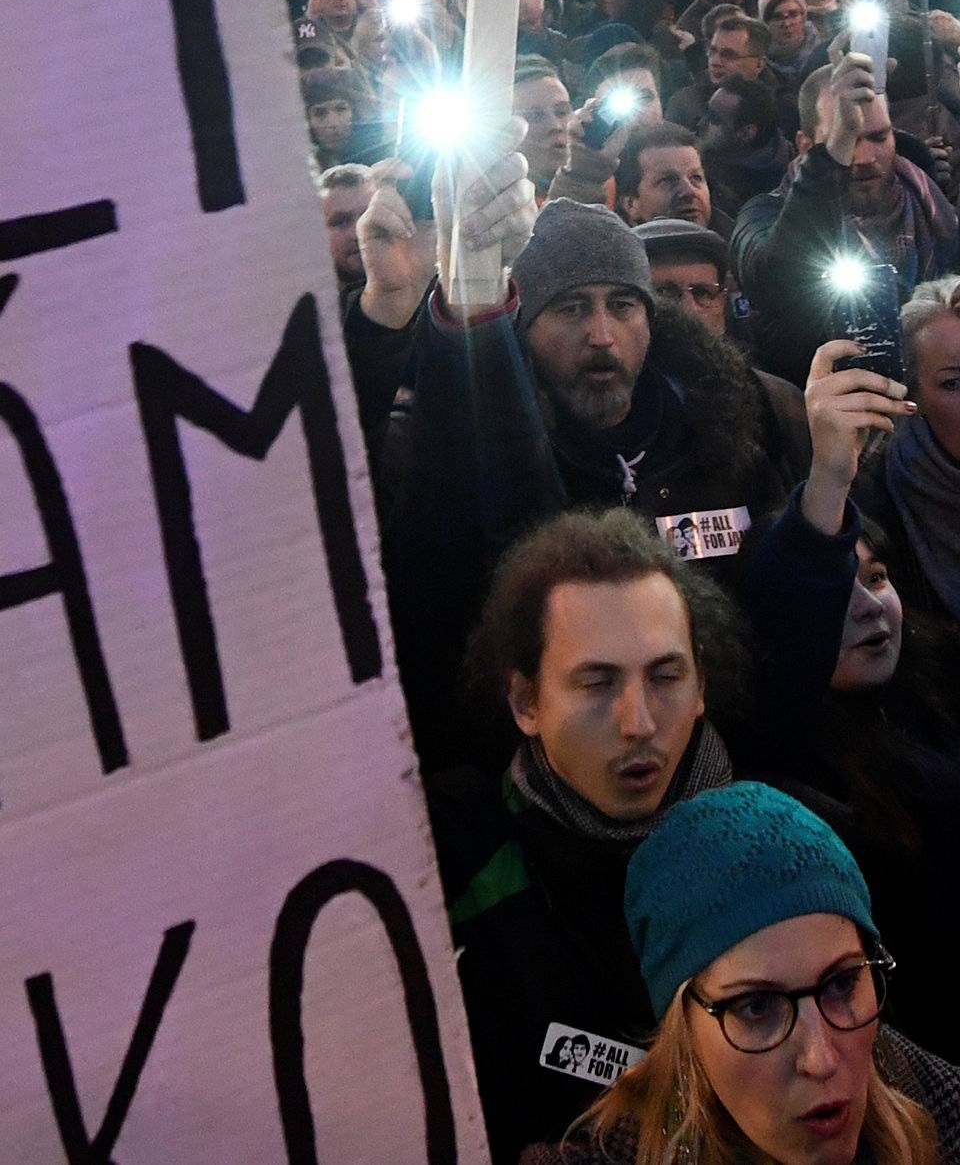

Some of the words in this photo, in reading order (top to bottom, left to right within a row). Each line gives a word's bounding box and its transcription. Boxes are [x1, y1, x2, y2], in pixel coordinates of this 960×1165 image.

[703, 532, 727, 550] FOR
[592, 1041, 630, 1066] #ALL
[587, 1057, 615, 1081] FOR
